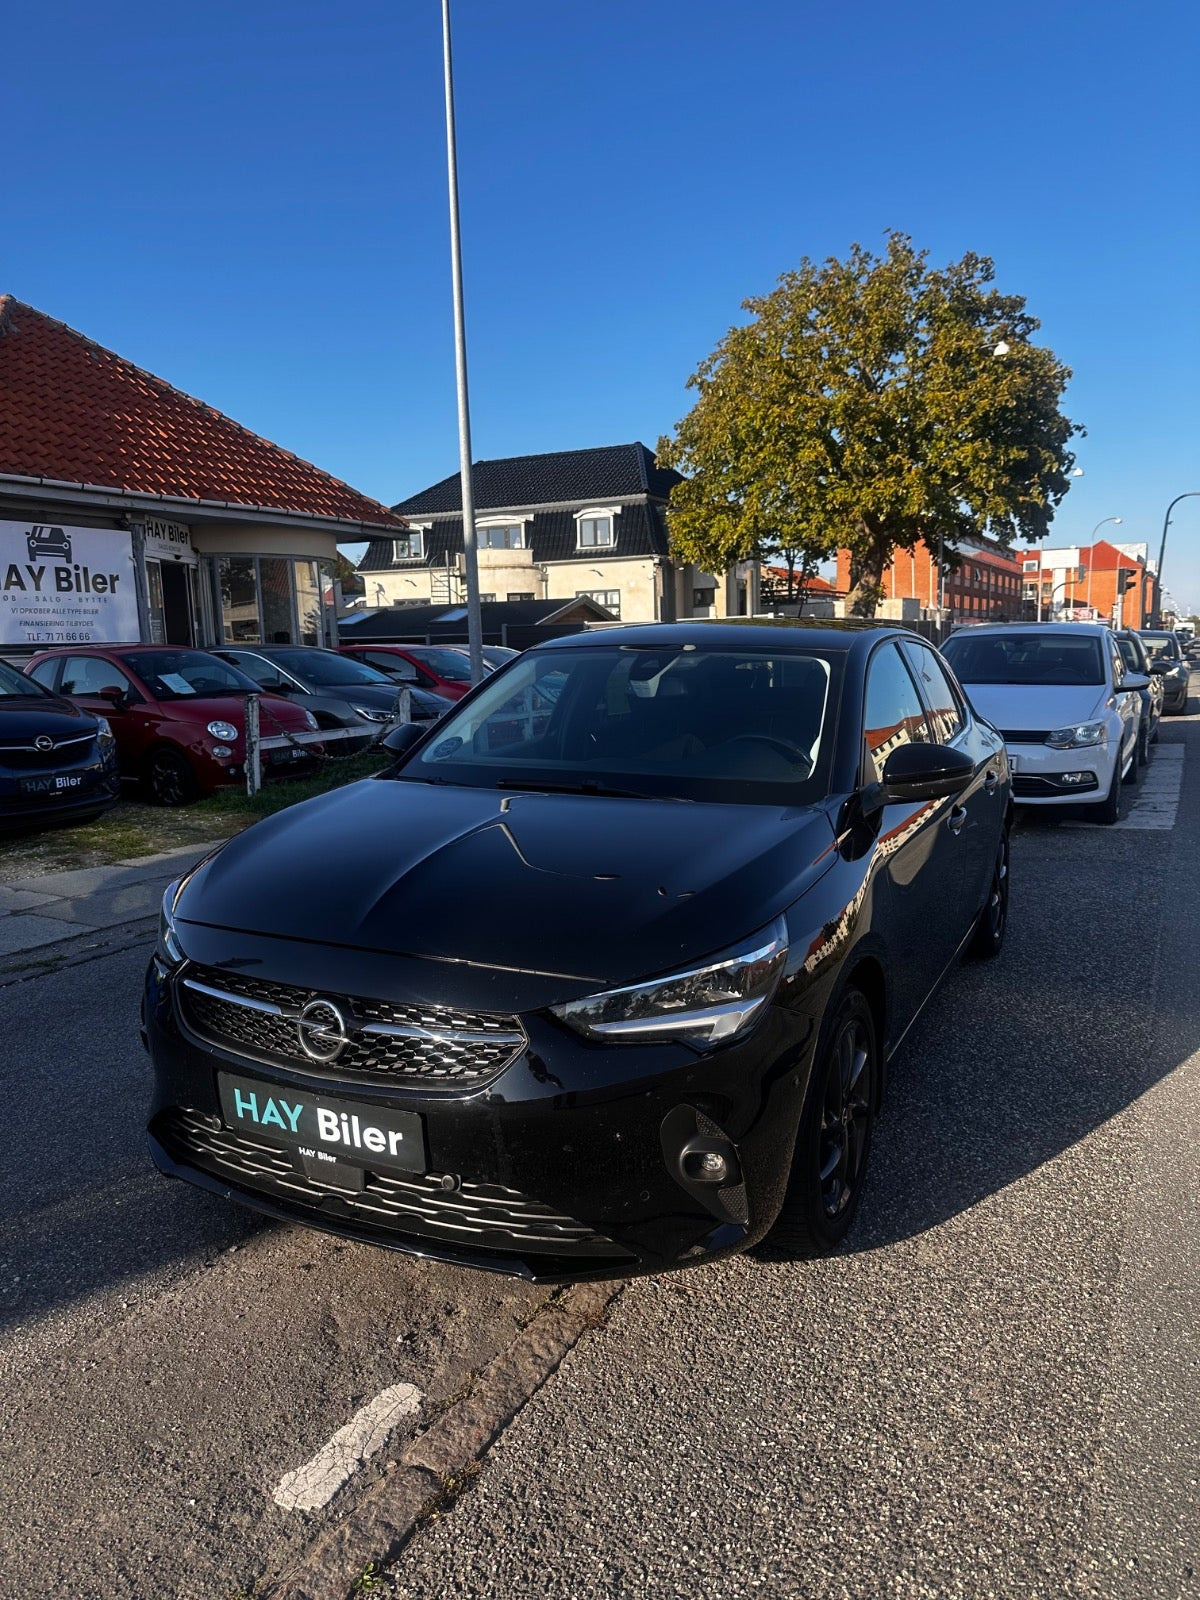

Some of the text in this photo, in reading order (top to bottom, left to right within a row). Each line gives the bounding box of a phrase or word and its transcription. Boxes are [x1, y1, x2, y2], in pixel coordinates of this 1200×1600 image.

[146, 520, 189, 545] HAY Biler
[0, 563, 120, 594] AY Biler
[65, 632, 78, 641] 66
[78, 632, 91, 641] 66
[26, 777, 81, 792] HAY Biler
[233, 1087, 404, 1157] HAY Biler
[298, 1146, 337, 1164] HAY Biler
